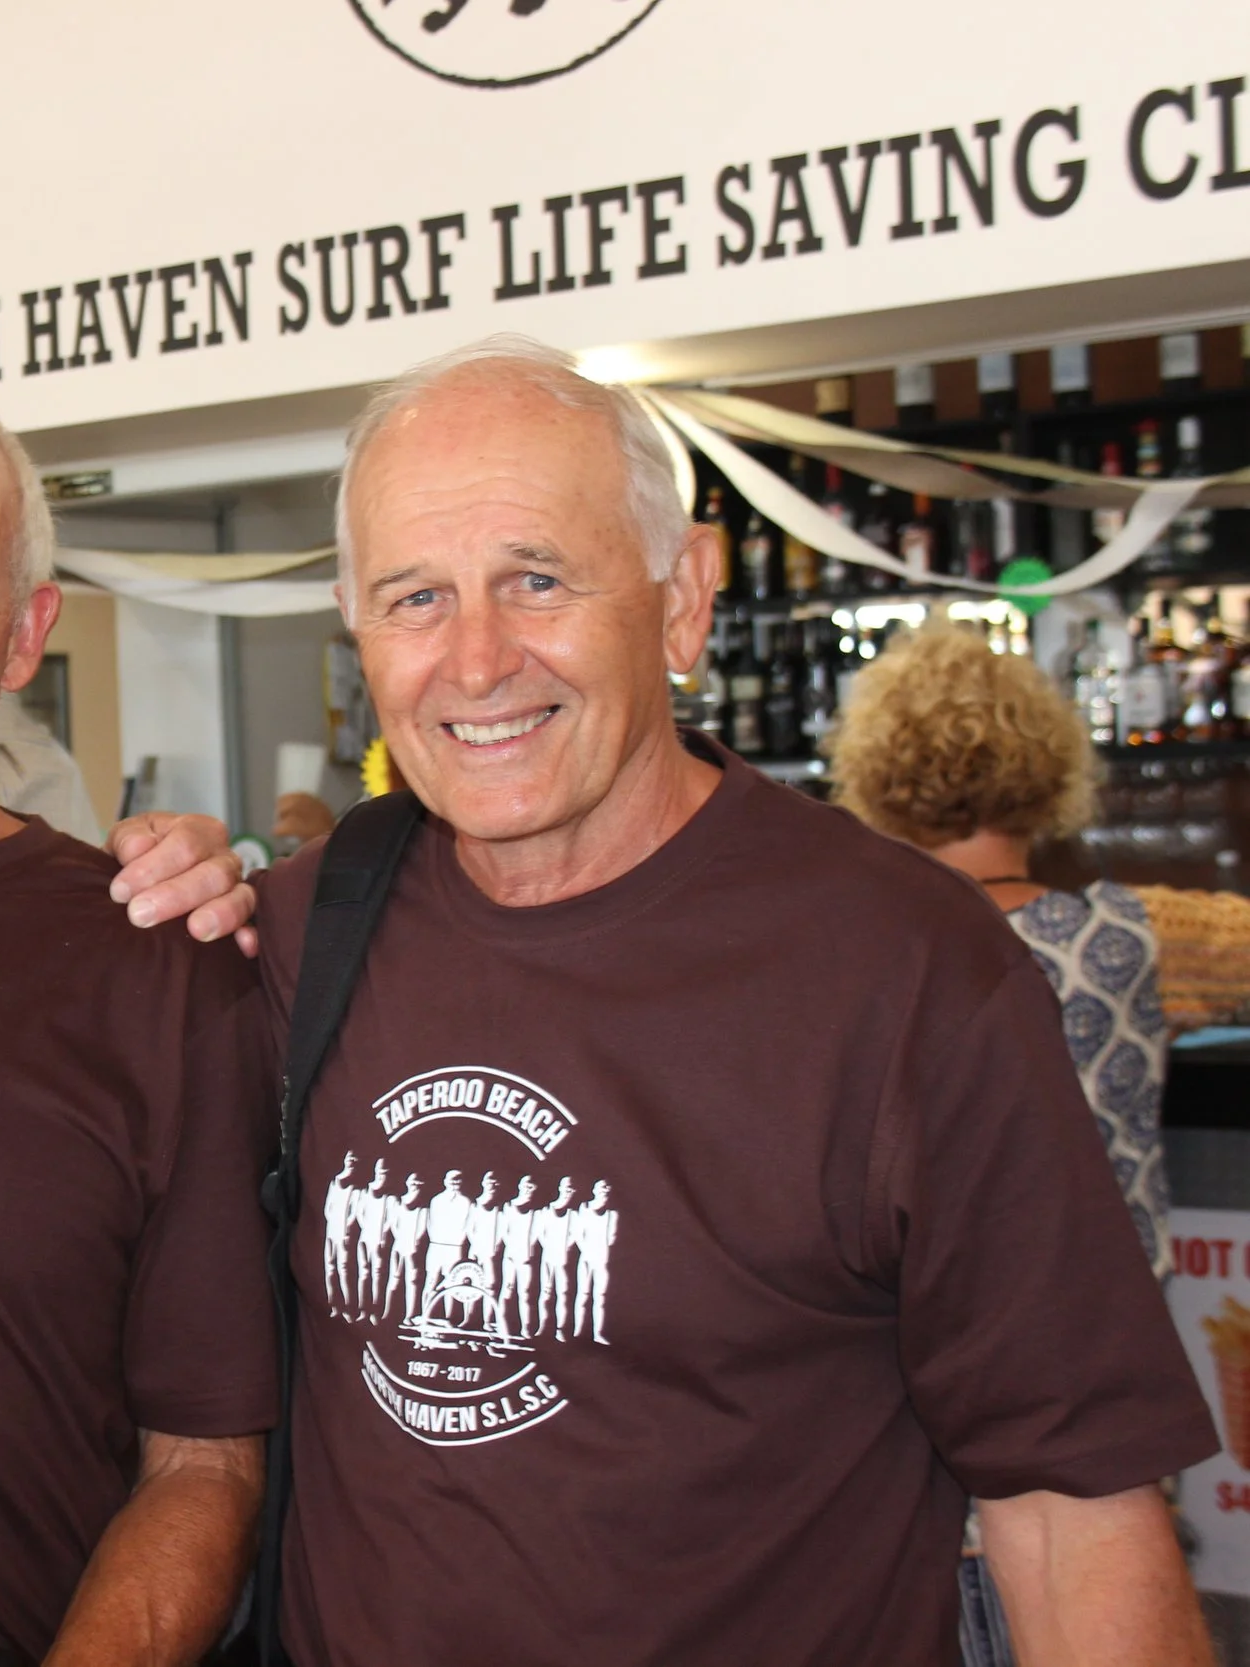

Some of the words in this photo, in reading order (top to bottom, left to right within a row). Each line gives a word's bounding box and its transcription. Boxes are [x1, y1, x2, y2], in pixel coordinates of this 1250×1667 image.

[20, 250, 253, 377] HAVEN
[277, 211, 466, 336] SURF
[492, 175, 688, 301] LIFE
[715, 105, 1088, 268] SAVING
[376, 1078, 484, 1135] TAPEROO
[485, 1083, 570, 1154] BEACH
[362, 1350, 403, 1417] NORTH
[404, 1399, 477, 1433] HAVEN
[480, 1374, 559, 1428] S.L.S.C
[407, 1360, 439, 1378] 1967
[447, 1366, 482, 1383] 2017
